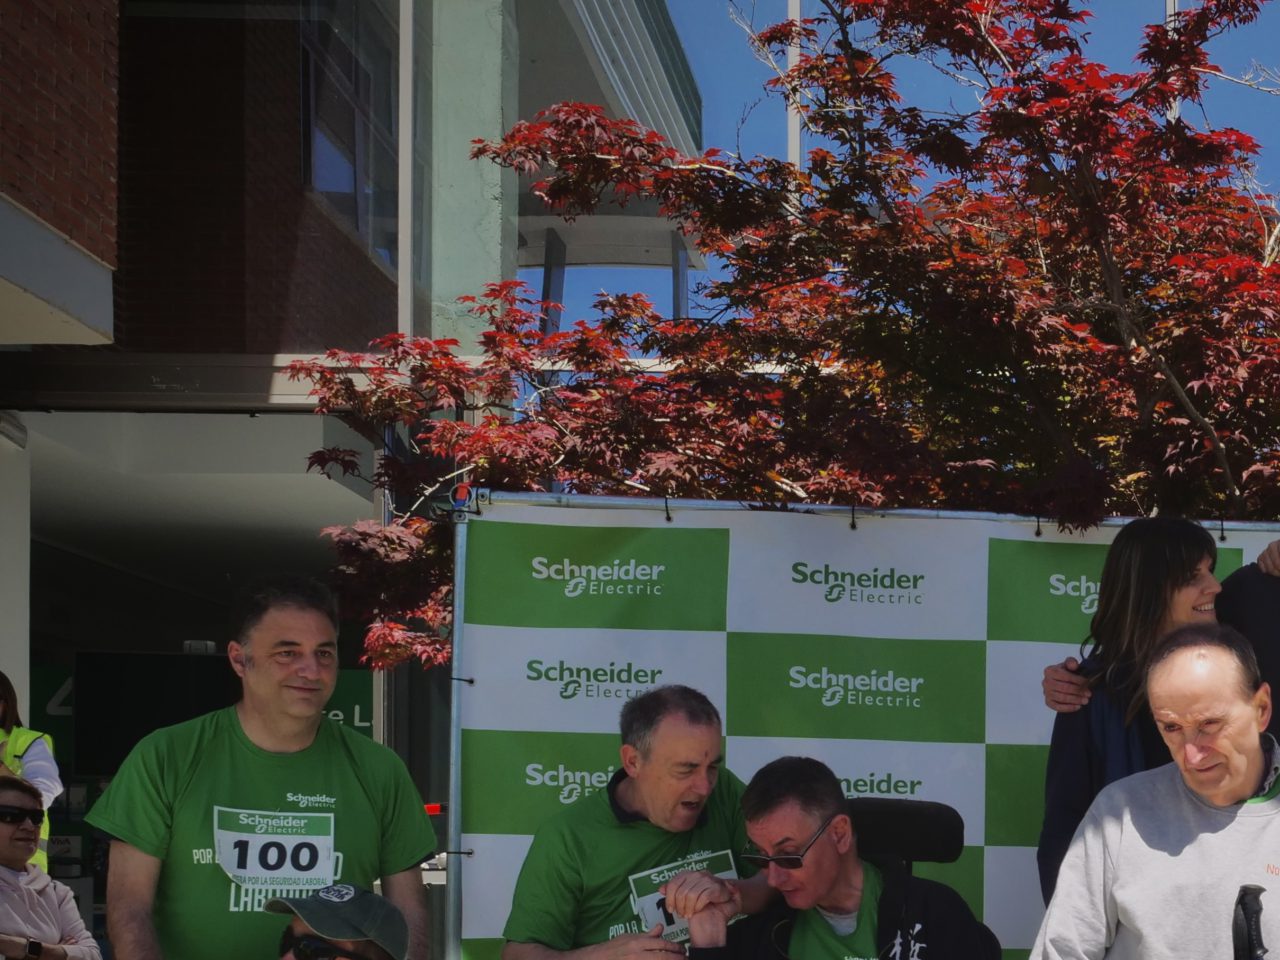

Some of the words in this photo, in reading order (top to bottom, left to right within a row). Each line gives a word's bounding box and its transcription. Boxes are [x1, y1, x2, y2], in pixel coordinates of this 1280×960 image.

[531, 556, 665, 581] Schneider
[791, 561, 925, 590] Schneider
[589, 581, 663, 595] Electric
[850, 589, 923, 605] Electric
[527, 659, 663, 684] Schneider
[789, 665, 925, 693] Schneider
[585, 684, 650, 699] Electr
[847, 690, 921, 708] Electric
[525, 763, 615, 788] Schnei
[838, 772, 923, 795] neider
[286, 792, 337, 804] Schneider
[238, 813, 308, 828] Schneider
[192, 848, 213, 864] POR
[233, 839, 319, 872] 100
